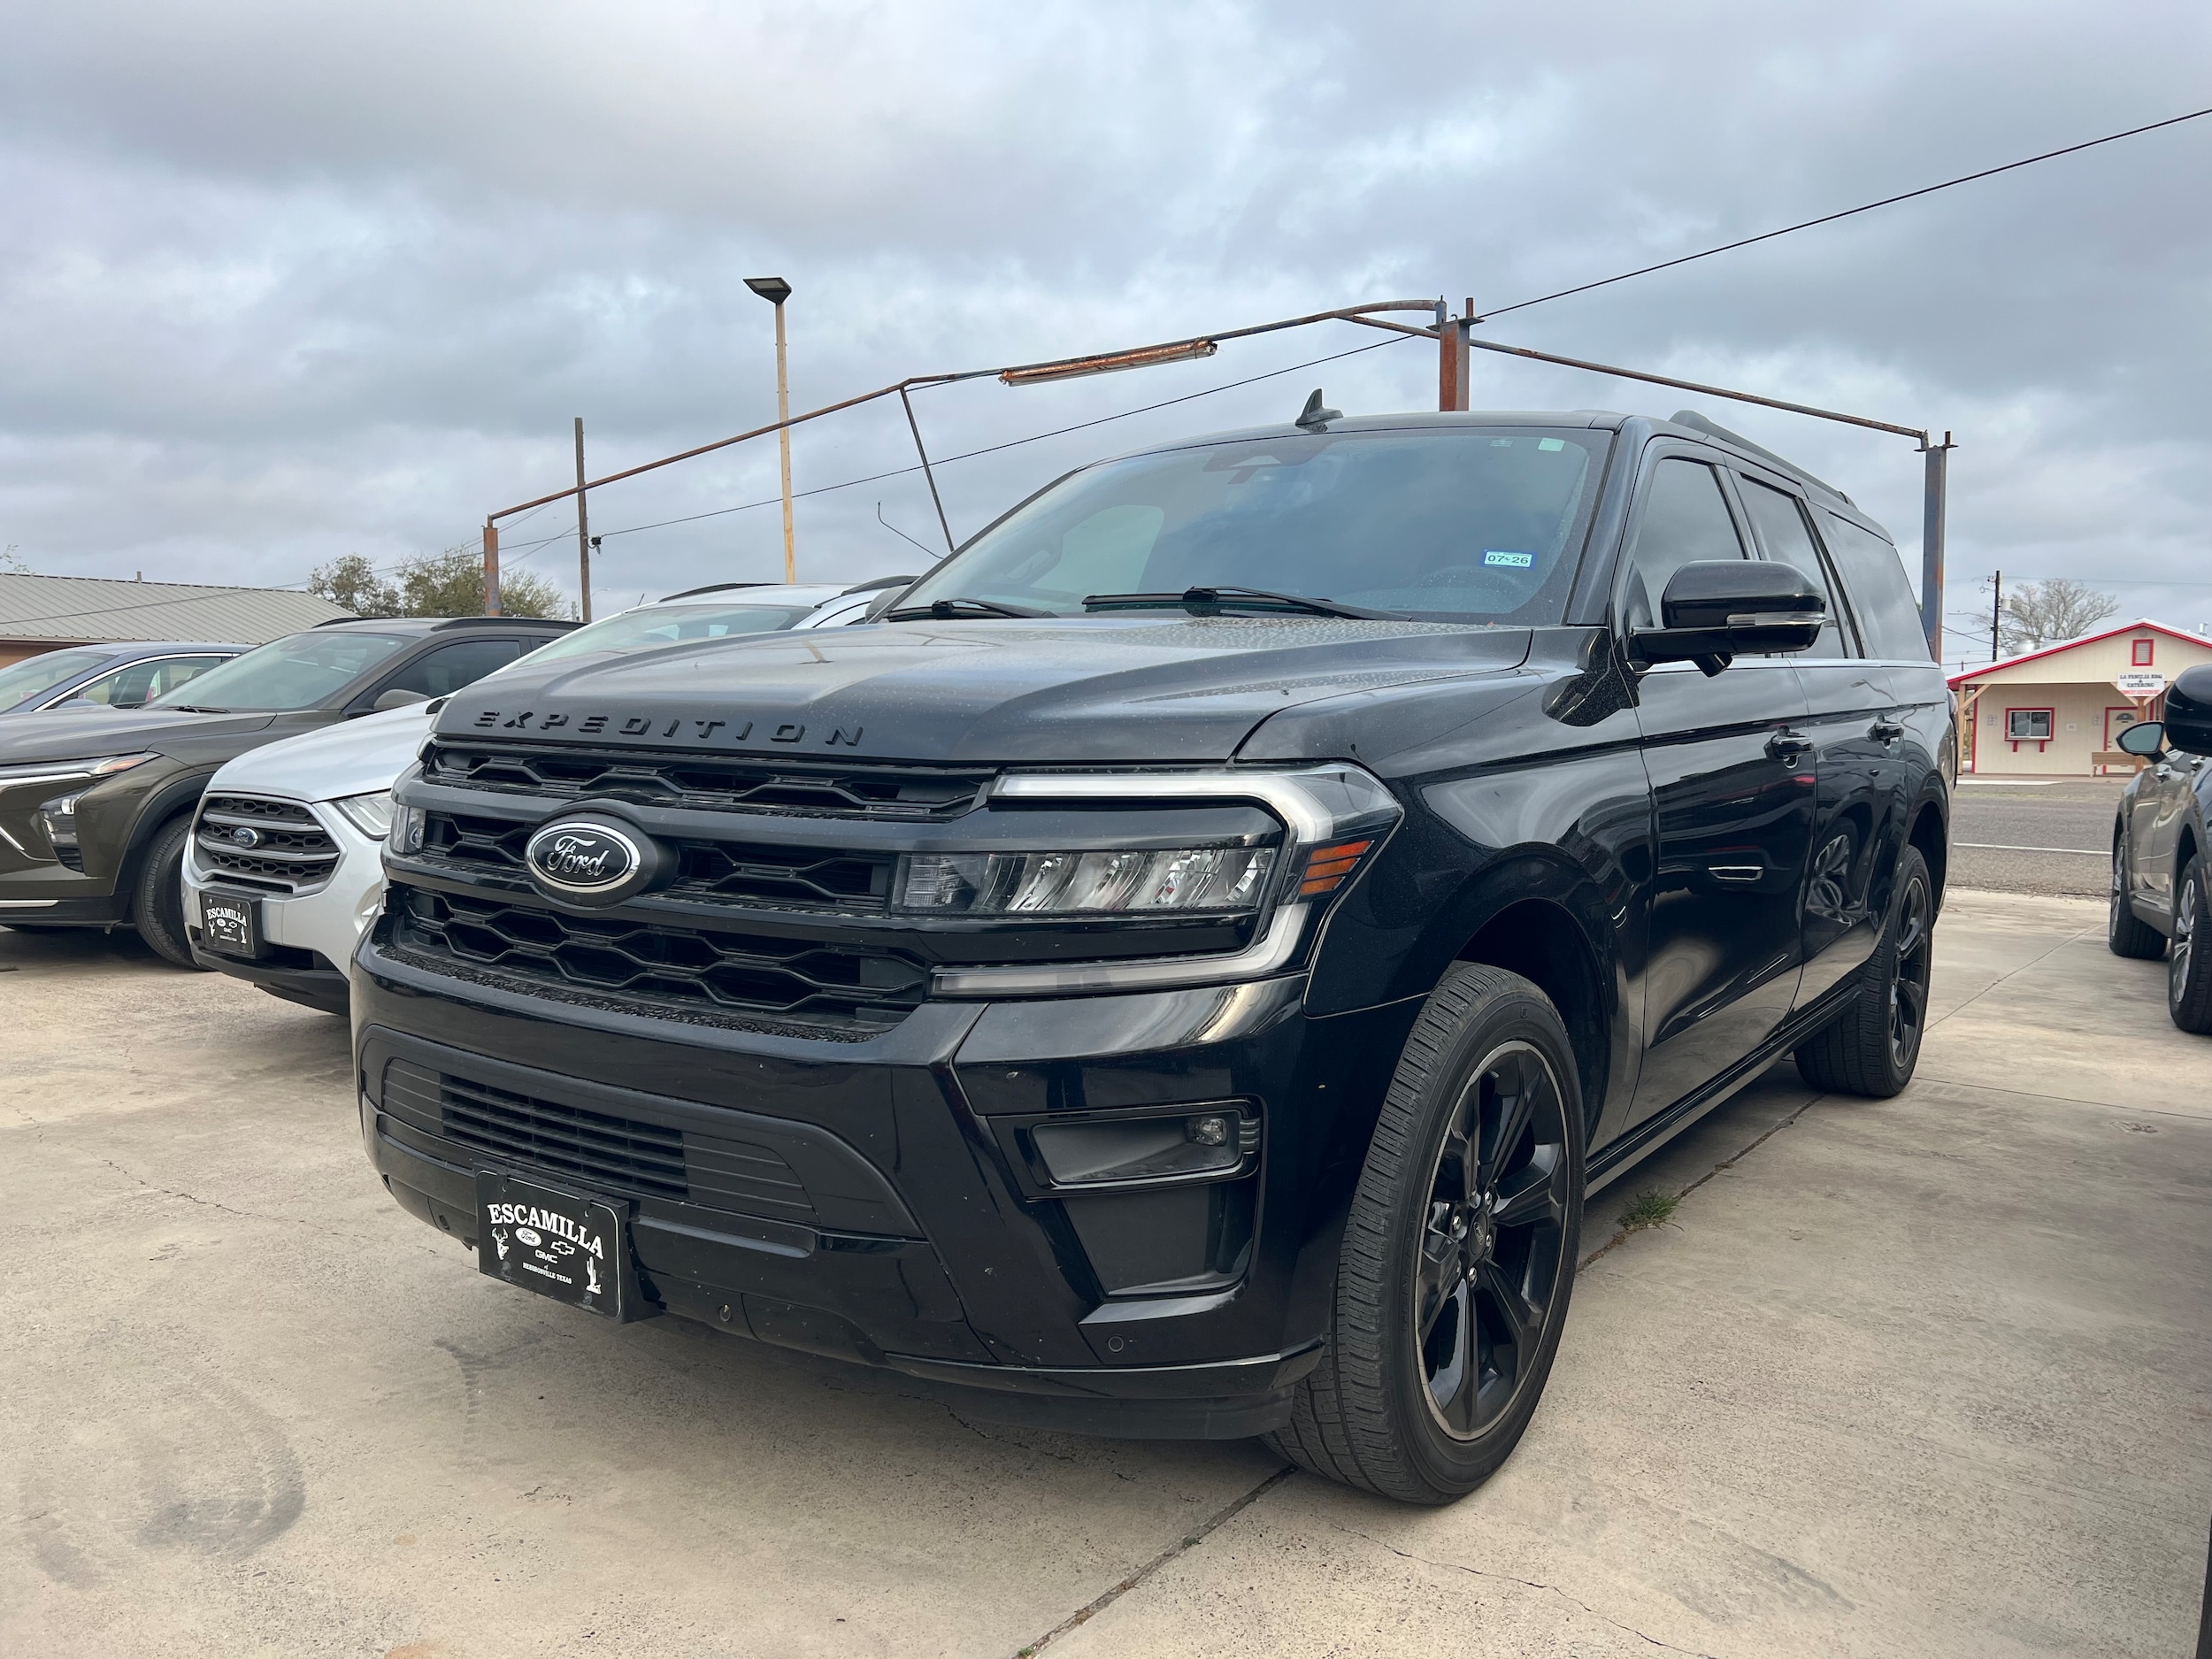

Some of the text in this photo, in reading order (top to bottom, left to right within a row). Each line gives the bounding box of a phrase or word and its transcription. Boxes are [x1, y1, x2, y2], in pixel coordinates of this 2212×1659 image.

[473, 710, 864, 747] EXPEDITION
[547, 835, 610, 877] Ford
[206, 907, 247, 927] ESCAMILLA
[487, 1203, 604, 1260] ESCAMILLA
[521, 1230, 536, 1243] Ford
[534, 1248, 558, 1264] GMC
[556, 1273, 572, 1284] TEXAS
